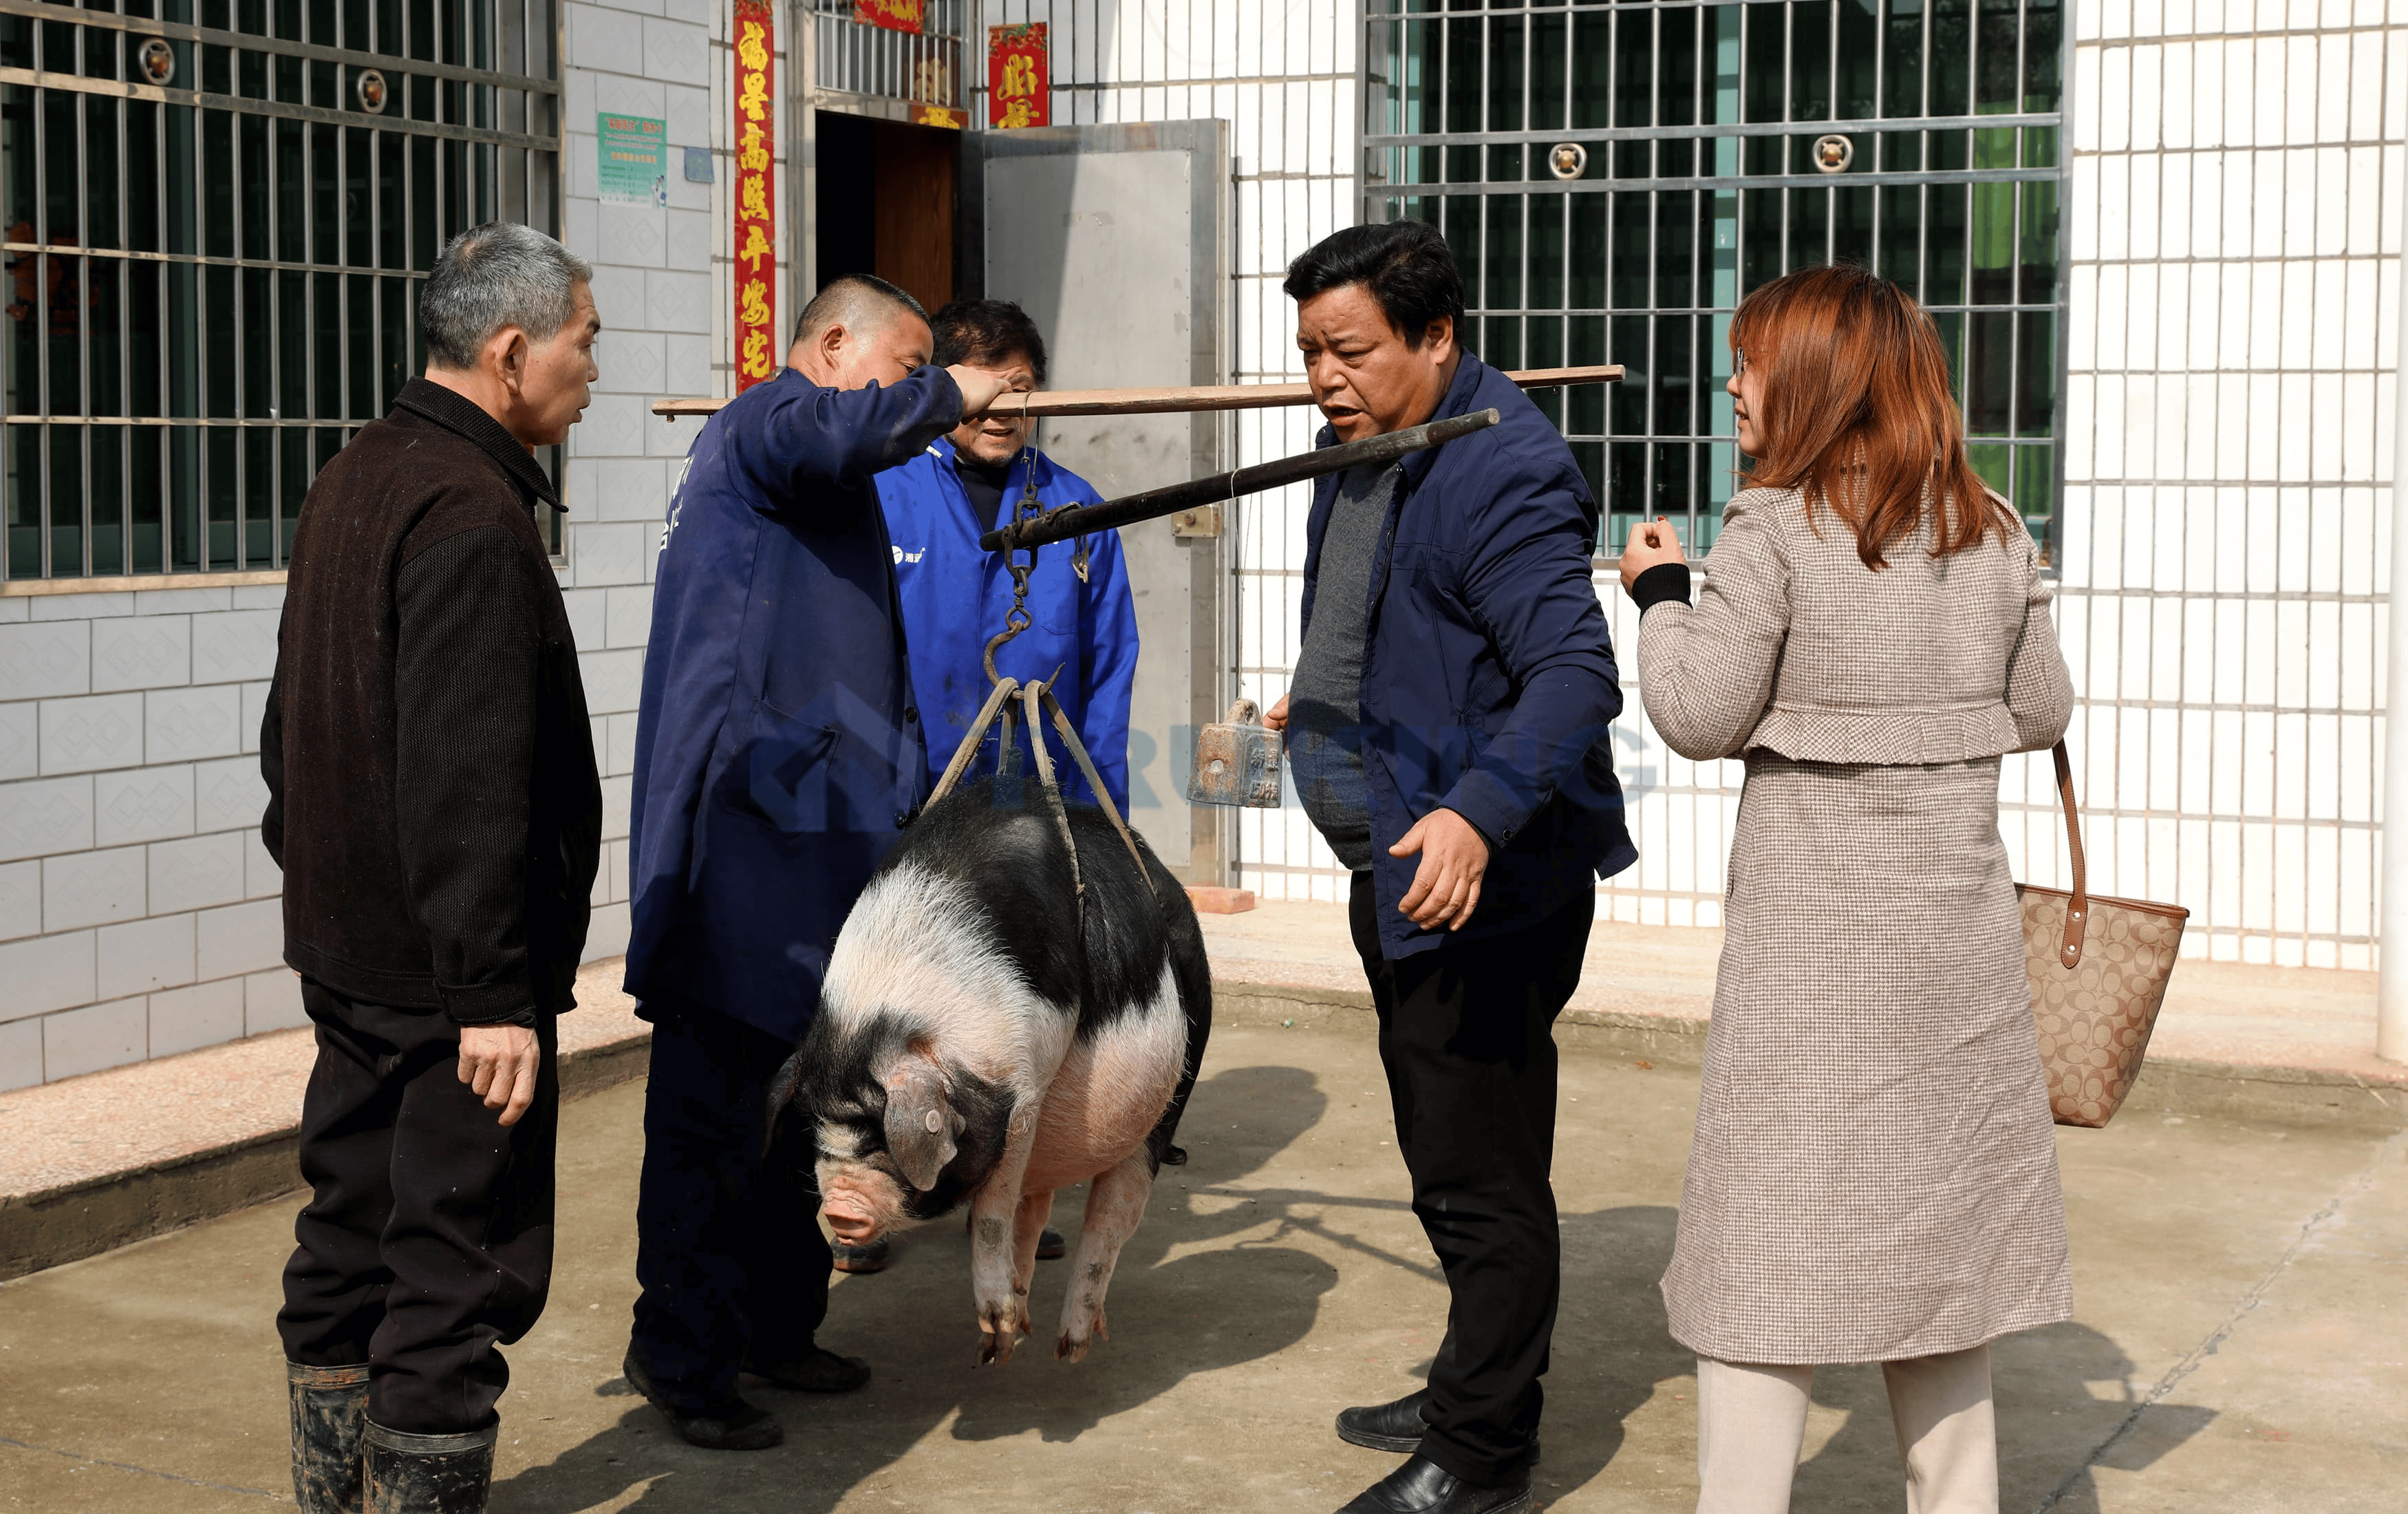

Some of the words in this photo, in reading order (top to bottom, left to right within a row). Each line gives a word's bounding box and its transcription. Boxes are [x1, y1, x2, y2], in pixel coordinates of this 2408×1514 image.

[738, 21, 770, 378] 福星高照平安宅
